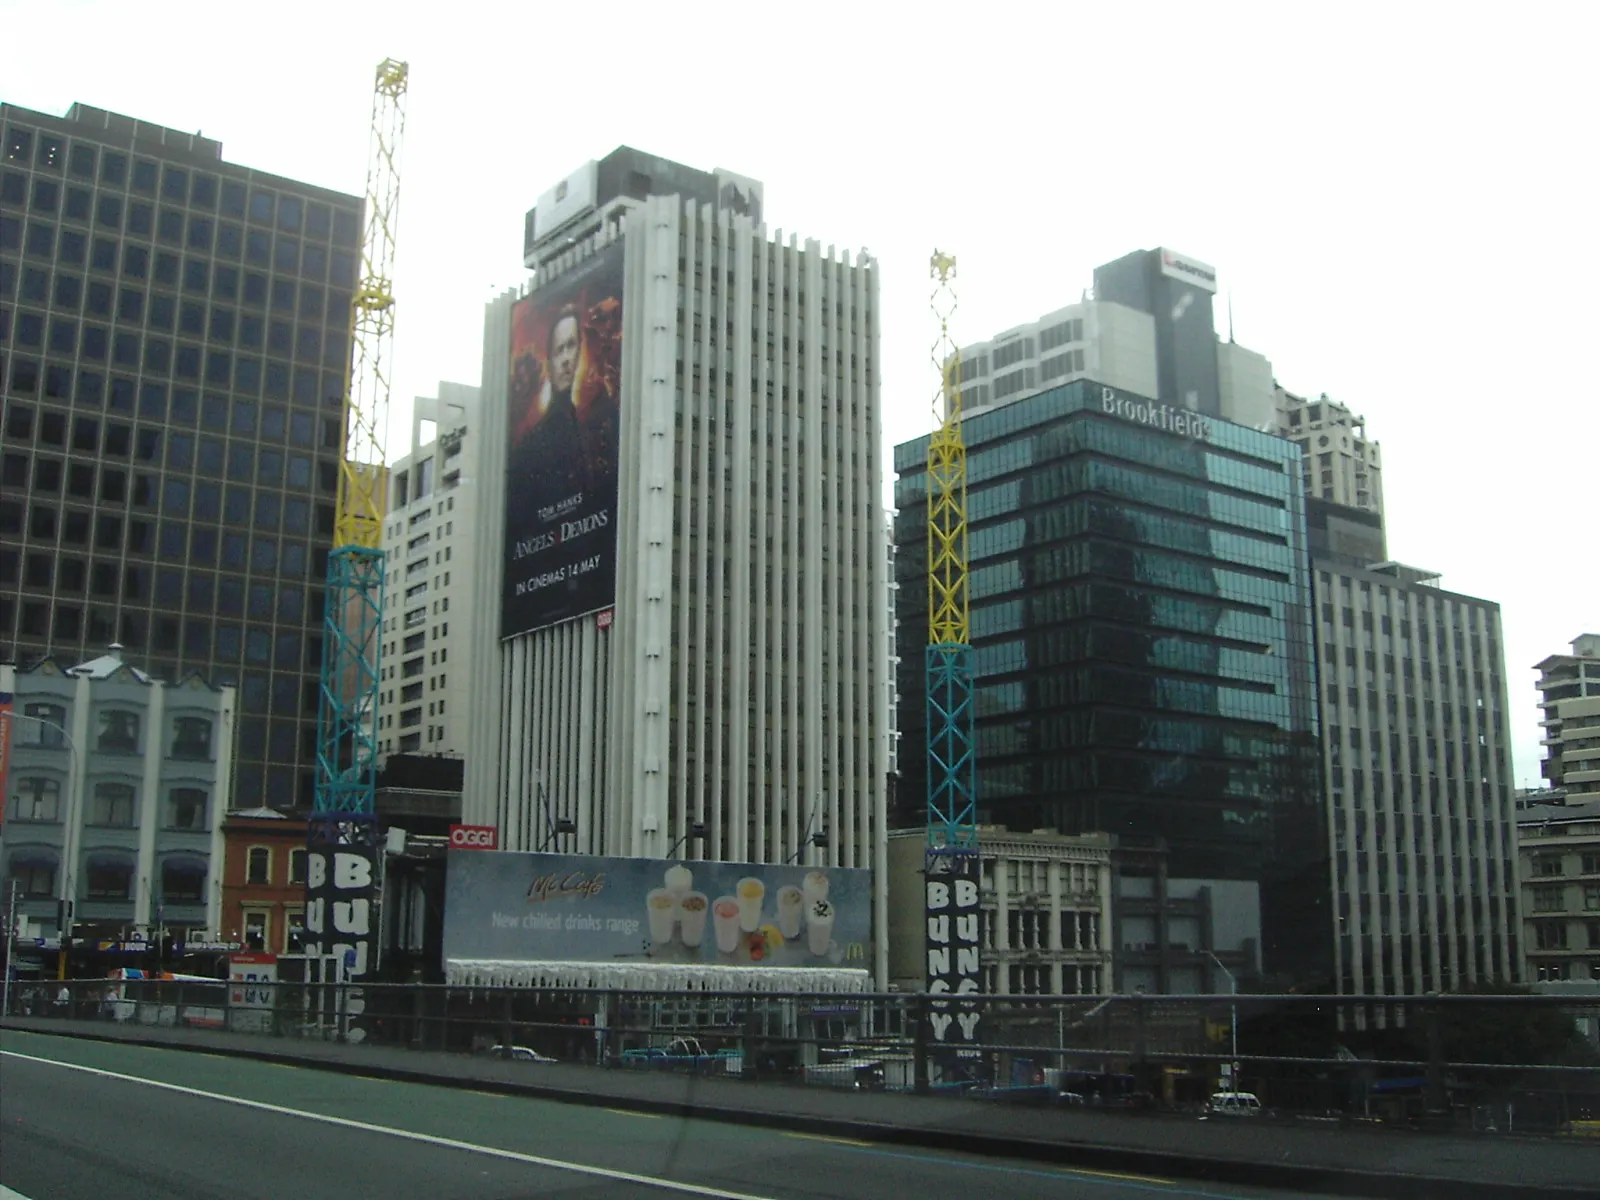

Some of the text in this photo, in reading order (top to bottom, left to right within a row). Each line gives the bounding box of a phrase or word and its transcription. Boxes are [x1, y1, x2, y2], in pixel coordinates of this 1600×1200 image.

[513, 509, 608, 560] ANGELS DEMONS
[516, 554, 601, 596] IN CINEMAS 14 MAY
[452, 829, 493, 846] OGGI
[492, 912, 640, 935] New chilled drinks range
